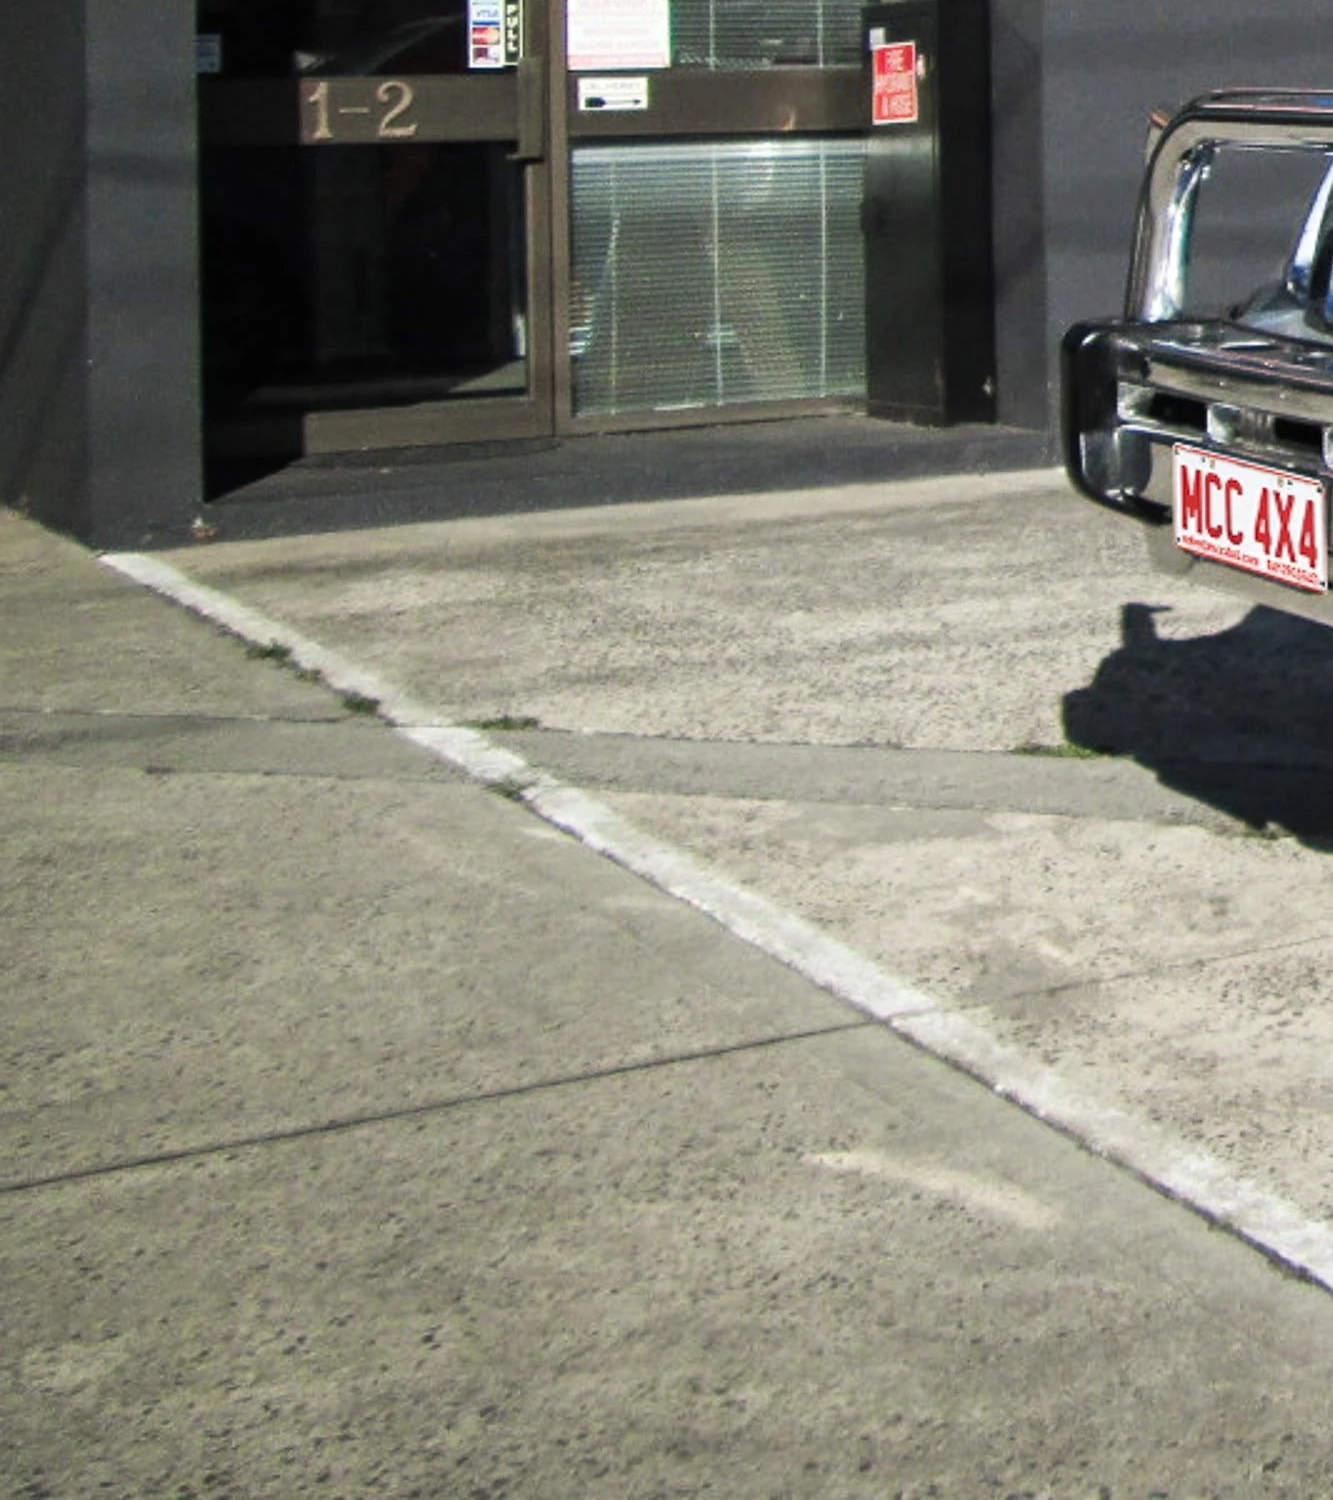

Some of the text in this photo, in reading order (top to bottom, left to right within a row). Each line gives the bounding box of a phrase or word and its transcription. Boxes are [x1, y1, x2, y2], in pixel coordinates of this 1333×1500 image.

[308, 81, 419, 140] 1-2
[1180, 464, 1244, 546] MCC
[1254, 487, 1319, 569] 4X4
